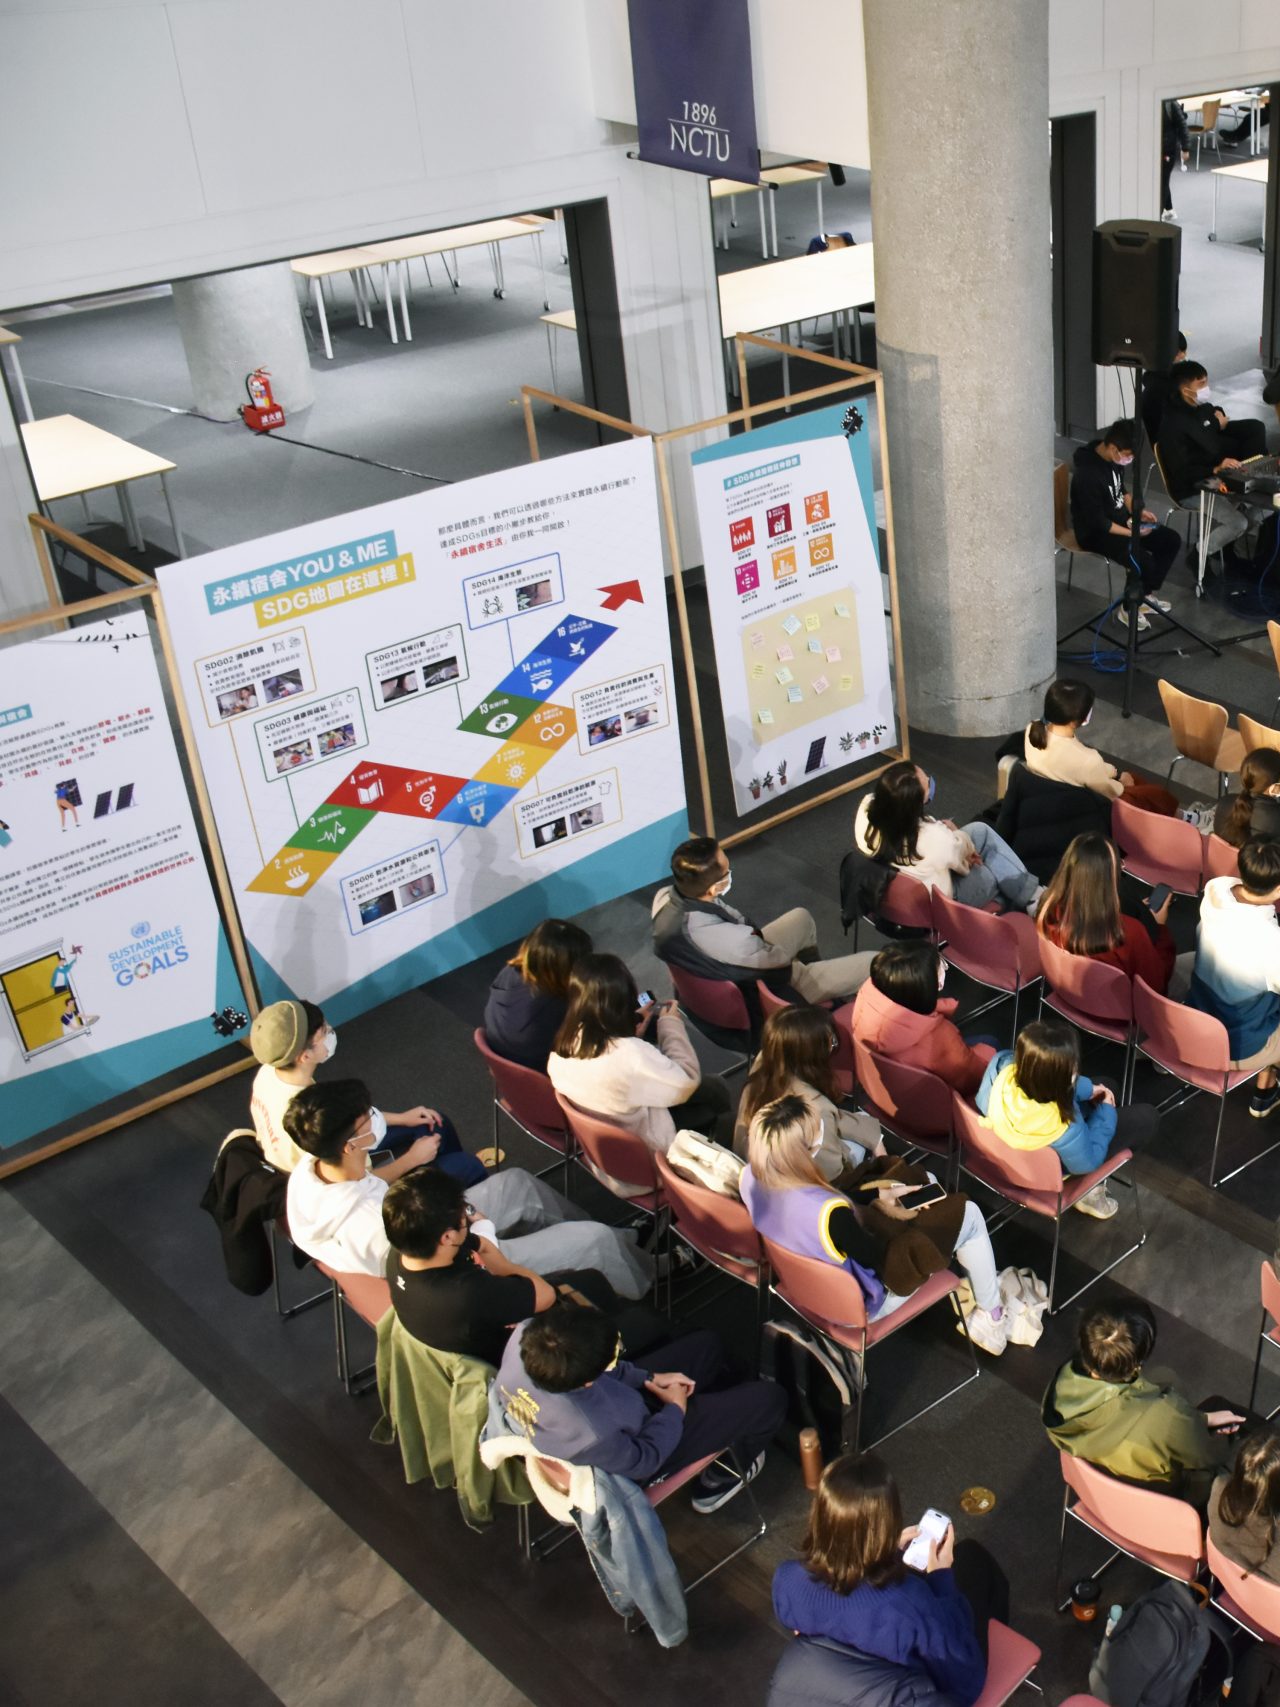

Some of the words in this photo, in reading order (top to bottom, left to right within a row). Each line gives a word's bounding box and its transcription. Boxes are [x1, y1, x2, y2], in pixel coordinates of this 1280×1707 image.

[682, 101, 717, 126] 1896
[670, 123, 730, 162] NCTU
[338, 549, 355, 568] &
[356, 539, 389, 563] ME
[204, 655, 234, 671] SDG02
[374, 649, 399, 663] SDG13
[264, 717, 292, 732] SDG03
[108, 925, 183, 962] SUSTAINABLE
[112, 936, 184, 973] DEVELOPMENT
[116, 945, 189, 987] GOALS
